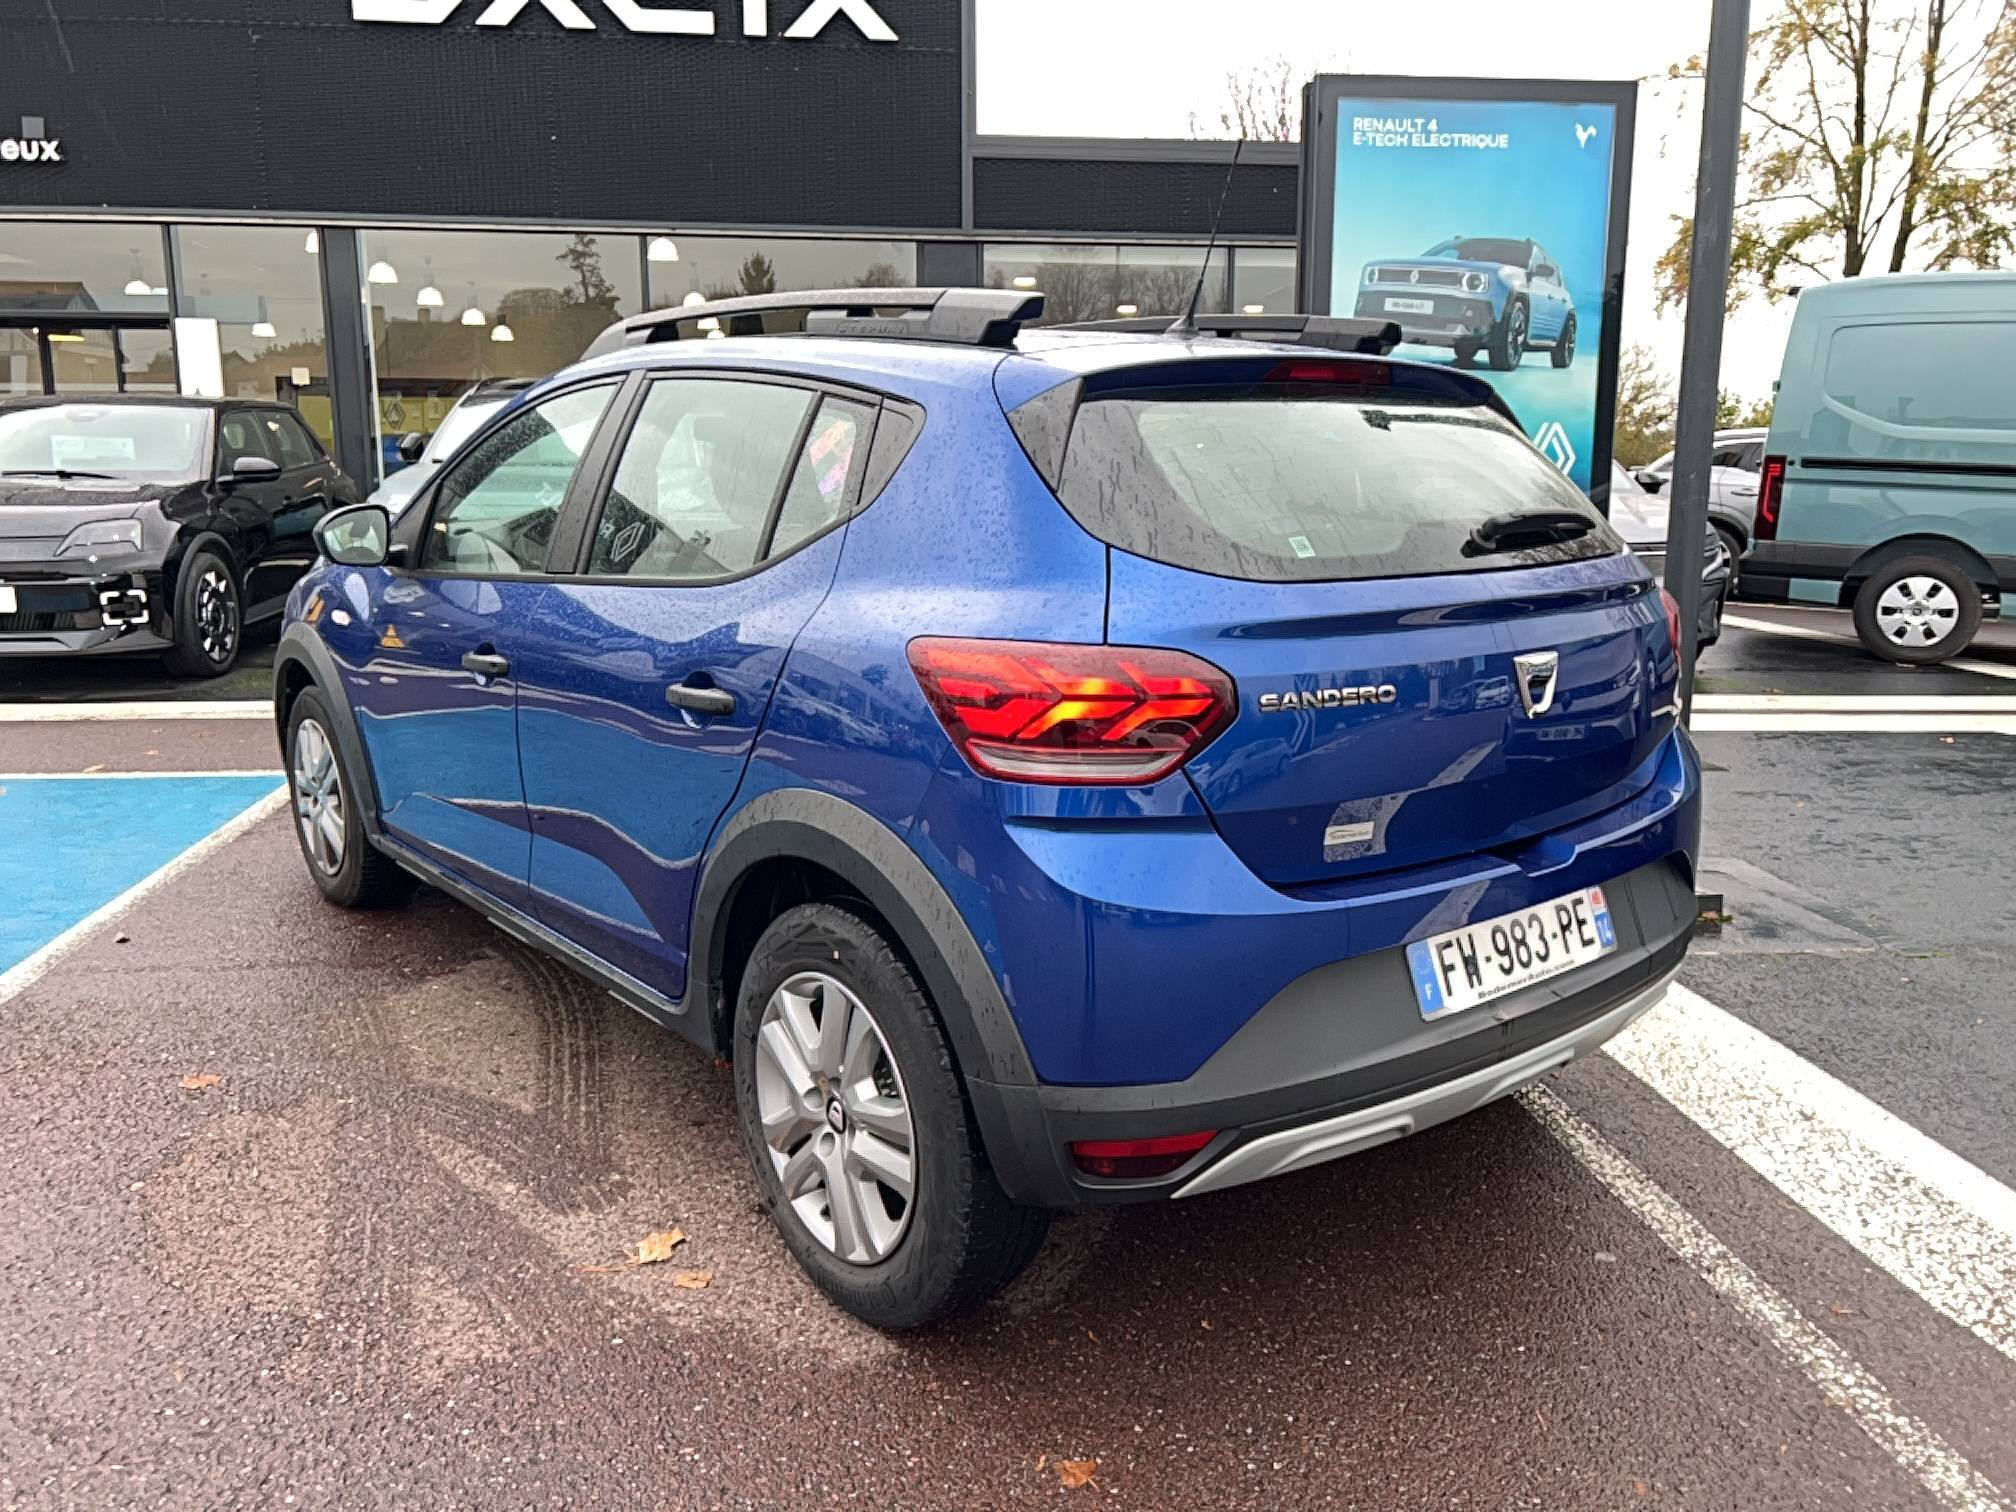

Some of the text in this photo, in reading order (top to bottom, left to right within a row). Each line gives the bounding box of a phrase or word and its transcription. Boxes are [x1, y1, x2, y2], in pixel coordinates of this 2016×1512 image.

[1353, 117, 1438, 133] RENAULT 4
[1353, 132, 1509, 149] E-TECH ELECTRIQUE
[1259, 684, 1397, 713] SANDERO
